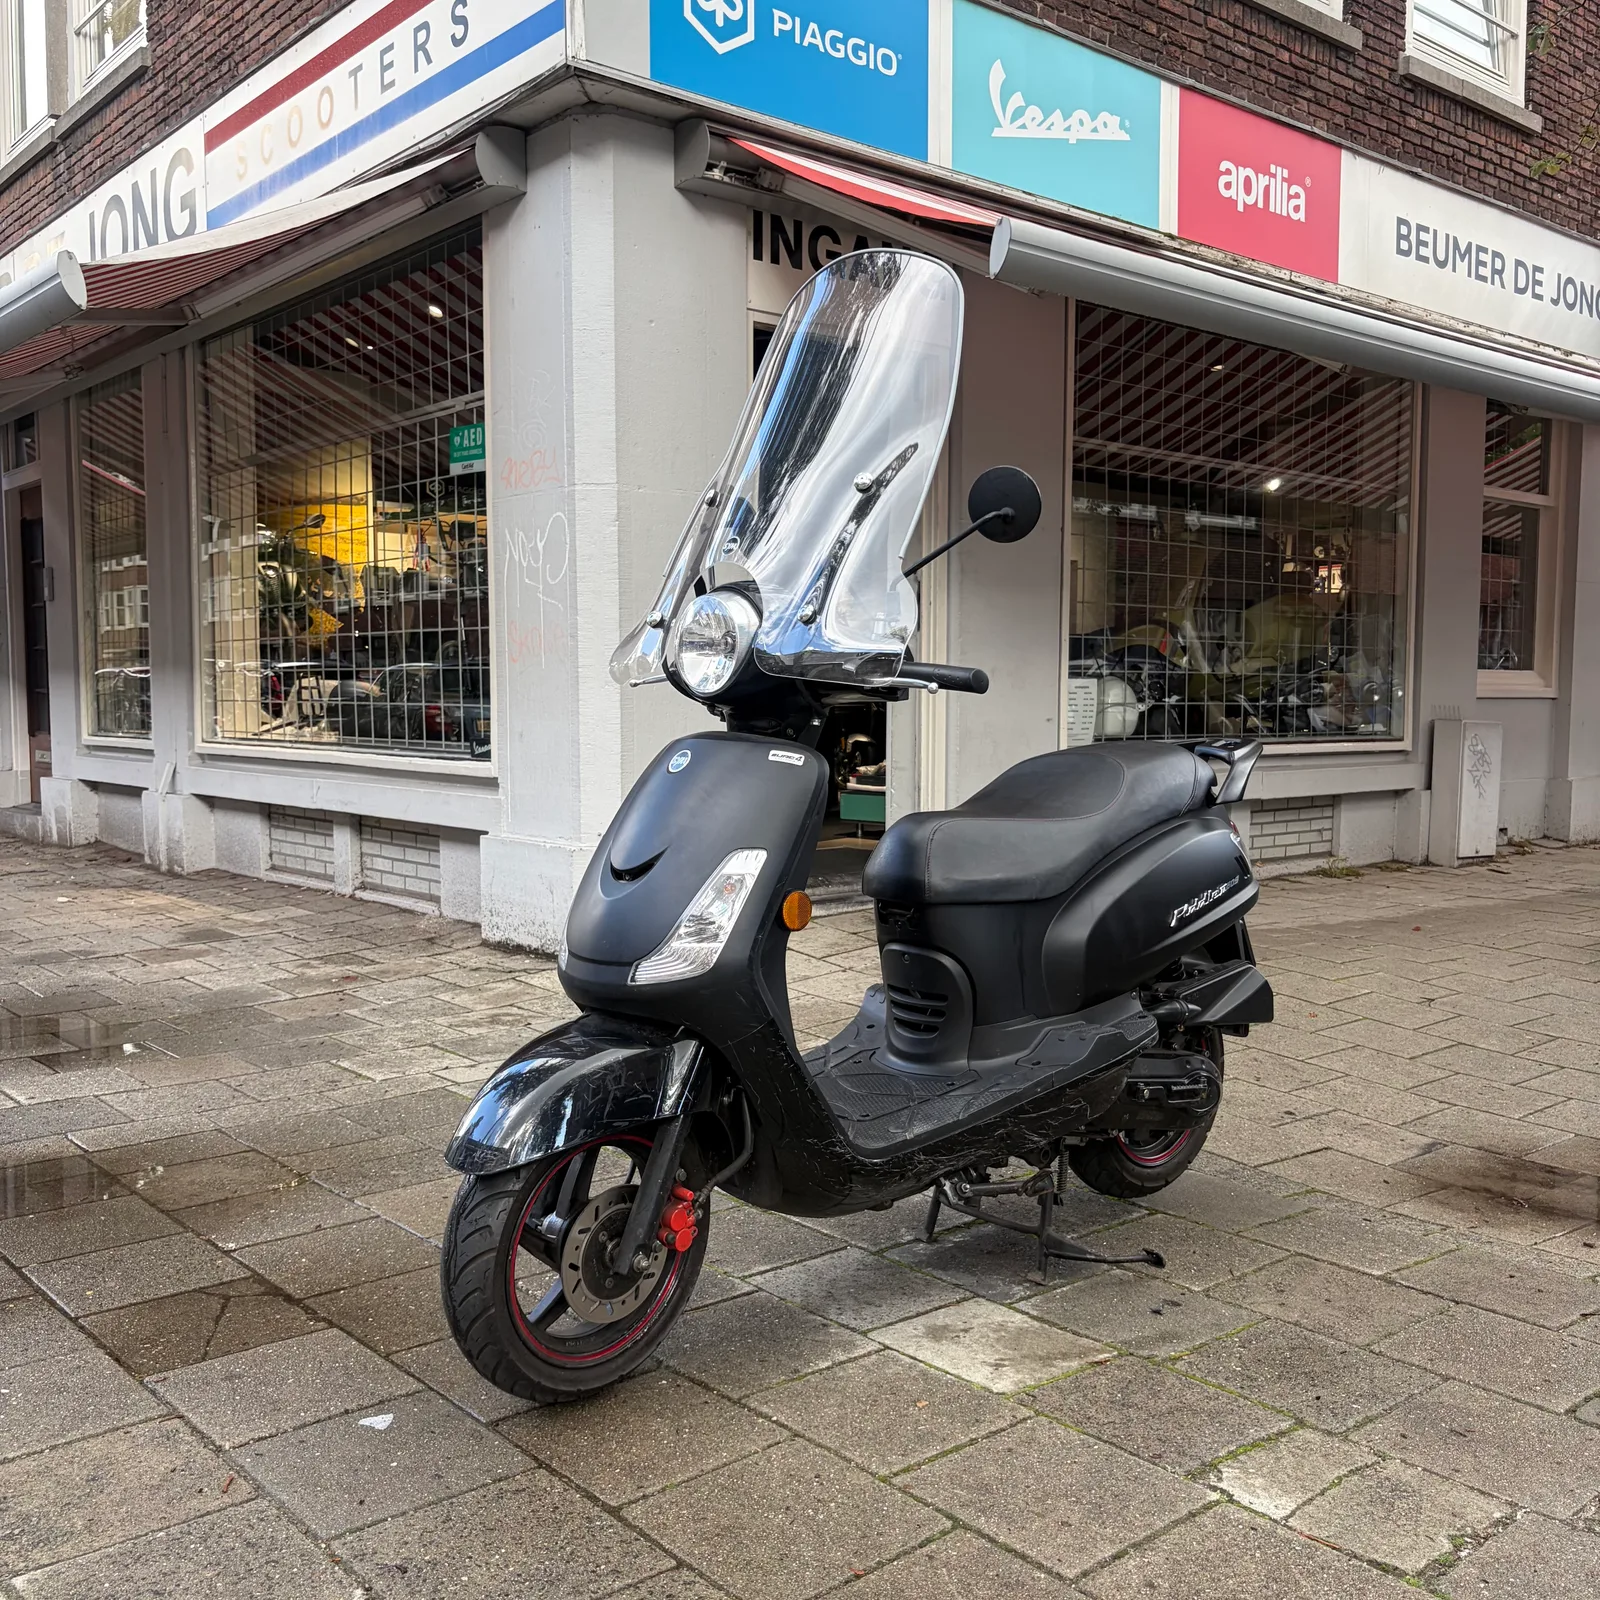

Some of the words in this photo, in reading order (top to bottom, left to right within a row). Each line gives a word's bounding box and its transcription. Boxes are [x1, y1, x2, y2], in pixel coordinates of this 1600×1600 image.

[772, 8, 898, 76] PIAGGIO
[236, 0, 470, 181] SCOOTERS
[989, 59, 1131, 144] Vespa
[1218, 160, 1306, 223] aprilia
[1395, 216, 1506, 290] BEUMER
[1513, 258, 1545, 302] DE
[463, 427, 483, 448] AED
